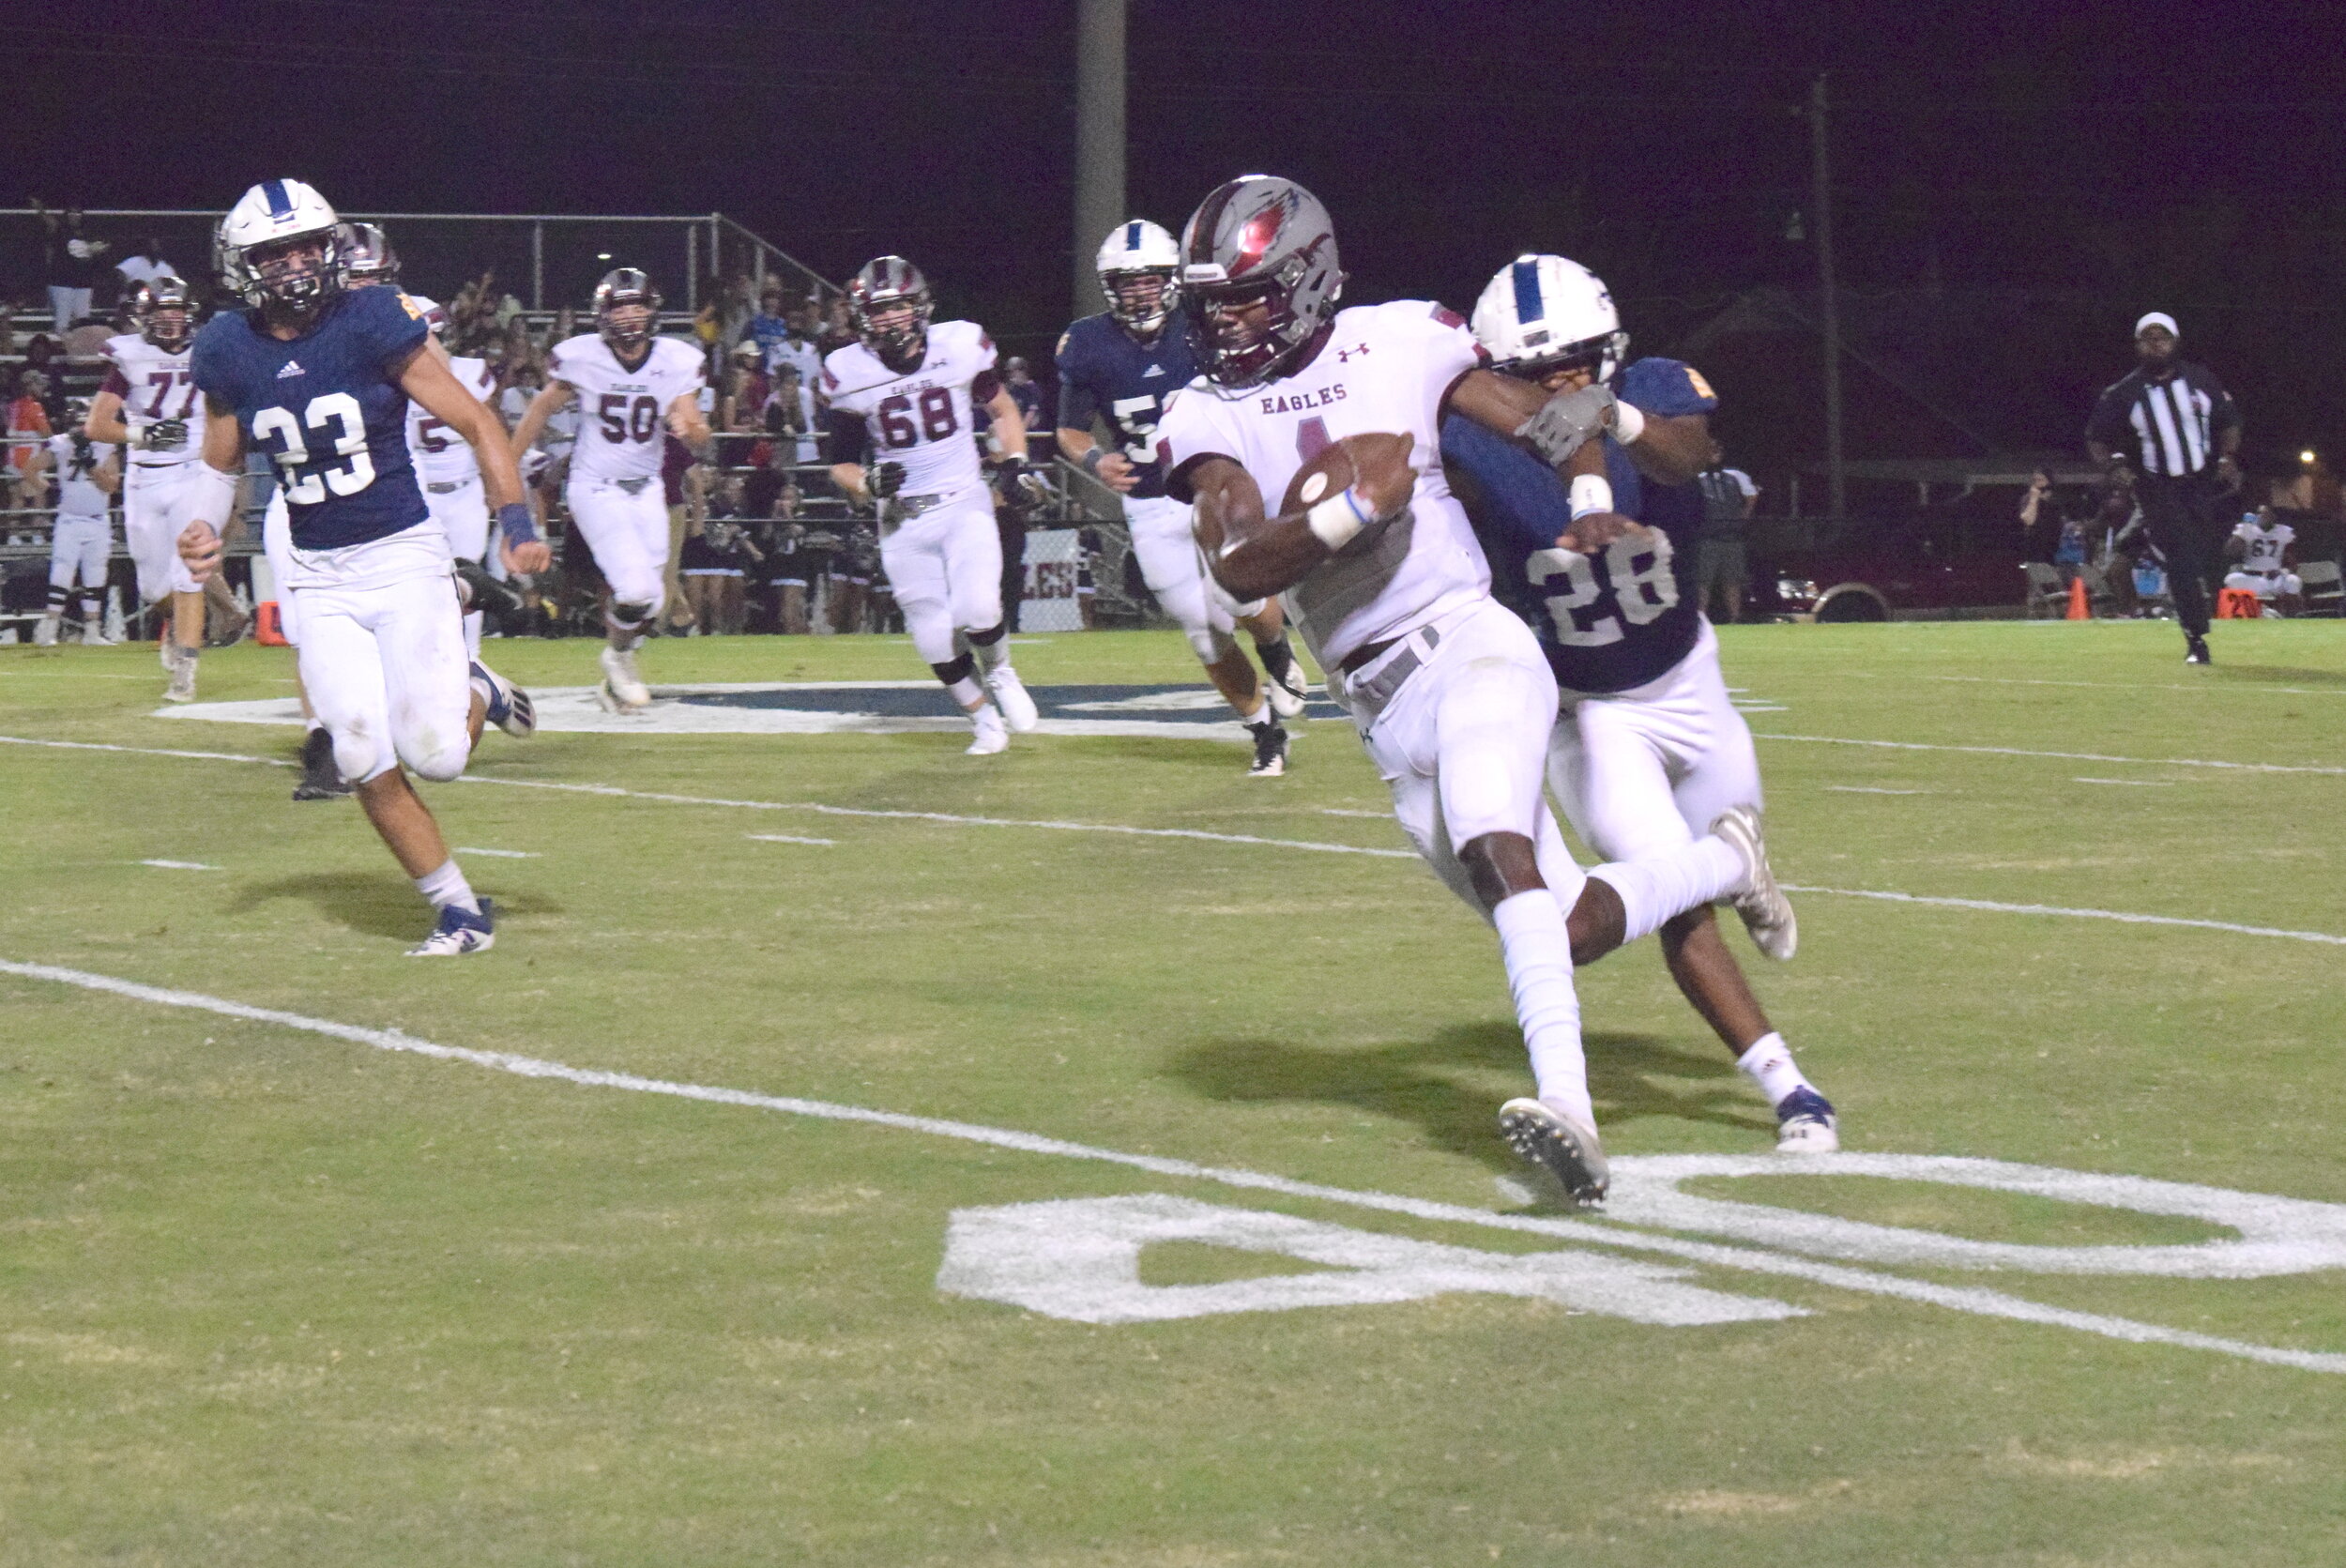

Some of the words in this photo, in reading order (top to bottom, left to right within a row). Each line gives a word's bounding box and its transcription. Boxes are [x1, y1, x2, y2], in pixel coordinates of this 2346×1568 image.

[145, 372, 195, 419] 77
[599, 394, 659, 445] 50
[879, 386, 958, 449] 68
[1260, 383, 1348, 415] EAGLES
[252, 391, 376, 505] 23
[1113, 388, 1184, 464] 5
[2253, 539, 2278, 557] 67
[1526, 525, 1681, 647] 28
